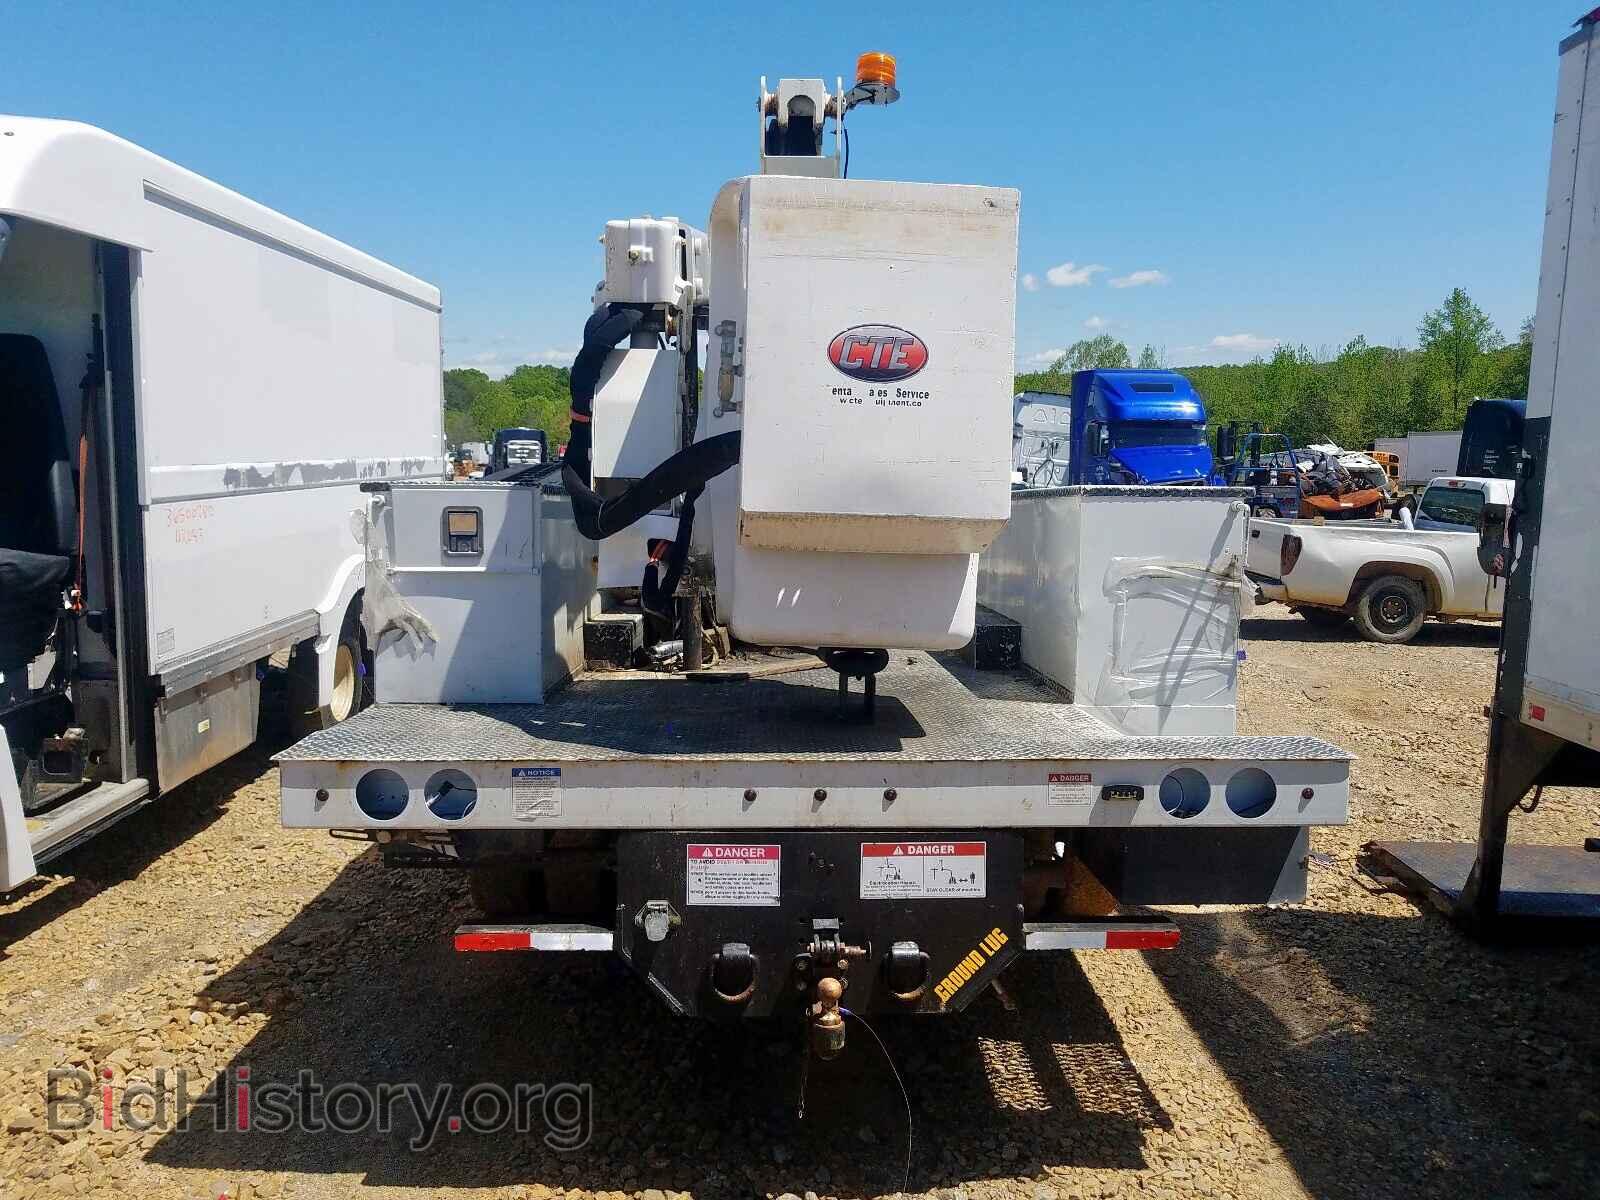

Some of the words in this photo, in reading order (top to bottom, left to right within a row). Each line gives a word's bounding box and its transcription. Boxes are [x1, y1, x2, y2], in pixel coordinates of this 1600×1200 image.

[838, 335, 915, 370] CTE
[895, 387, 930, 400] Service
[715, 847, 766, 858] DANGER
[907, 845, 955, 855] DANGER
[934, 950, 986, 1003] GROUND
[979, 927, 1009, 957] LUG
